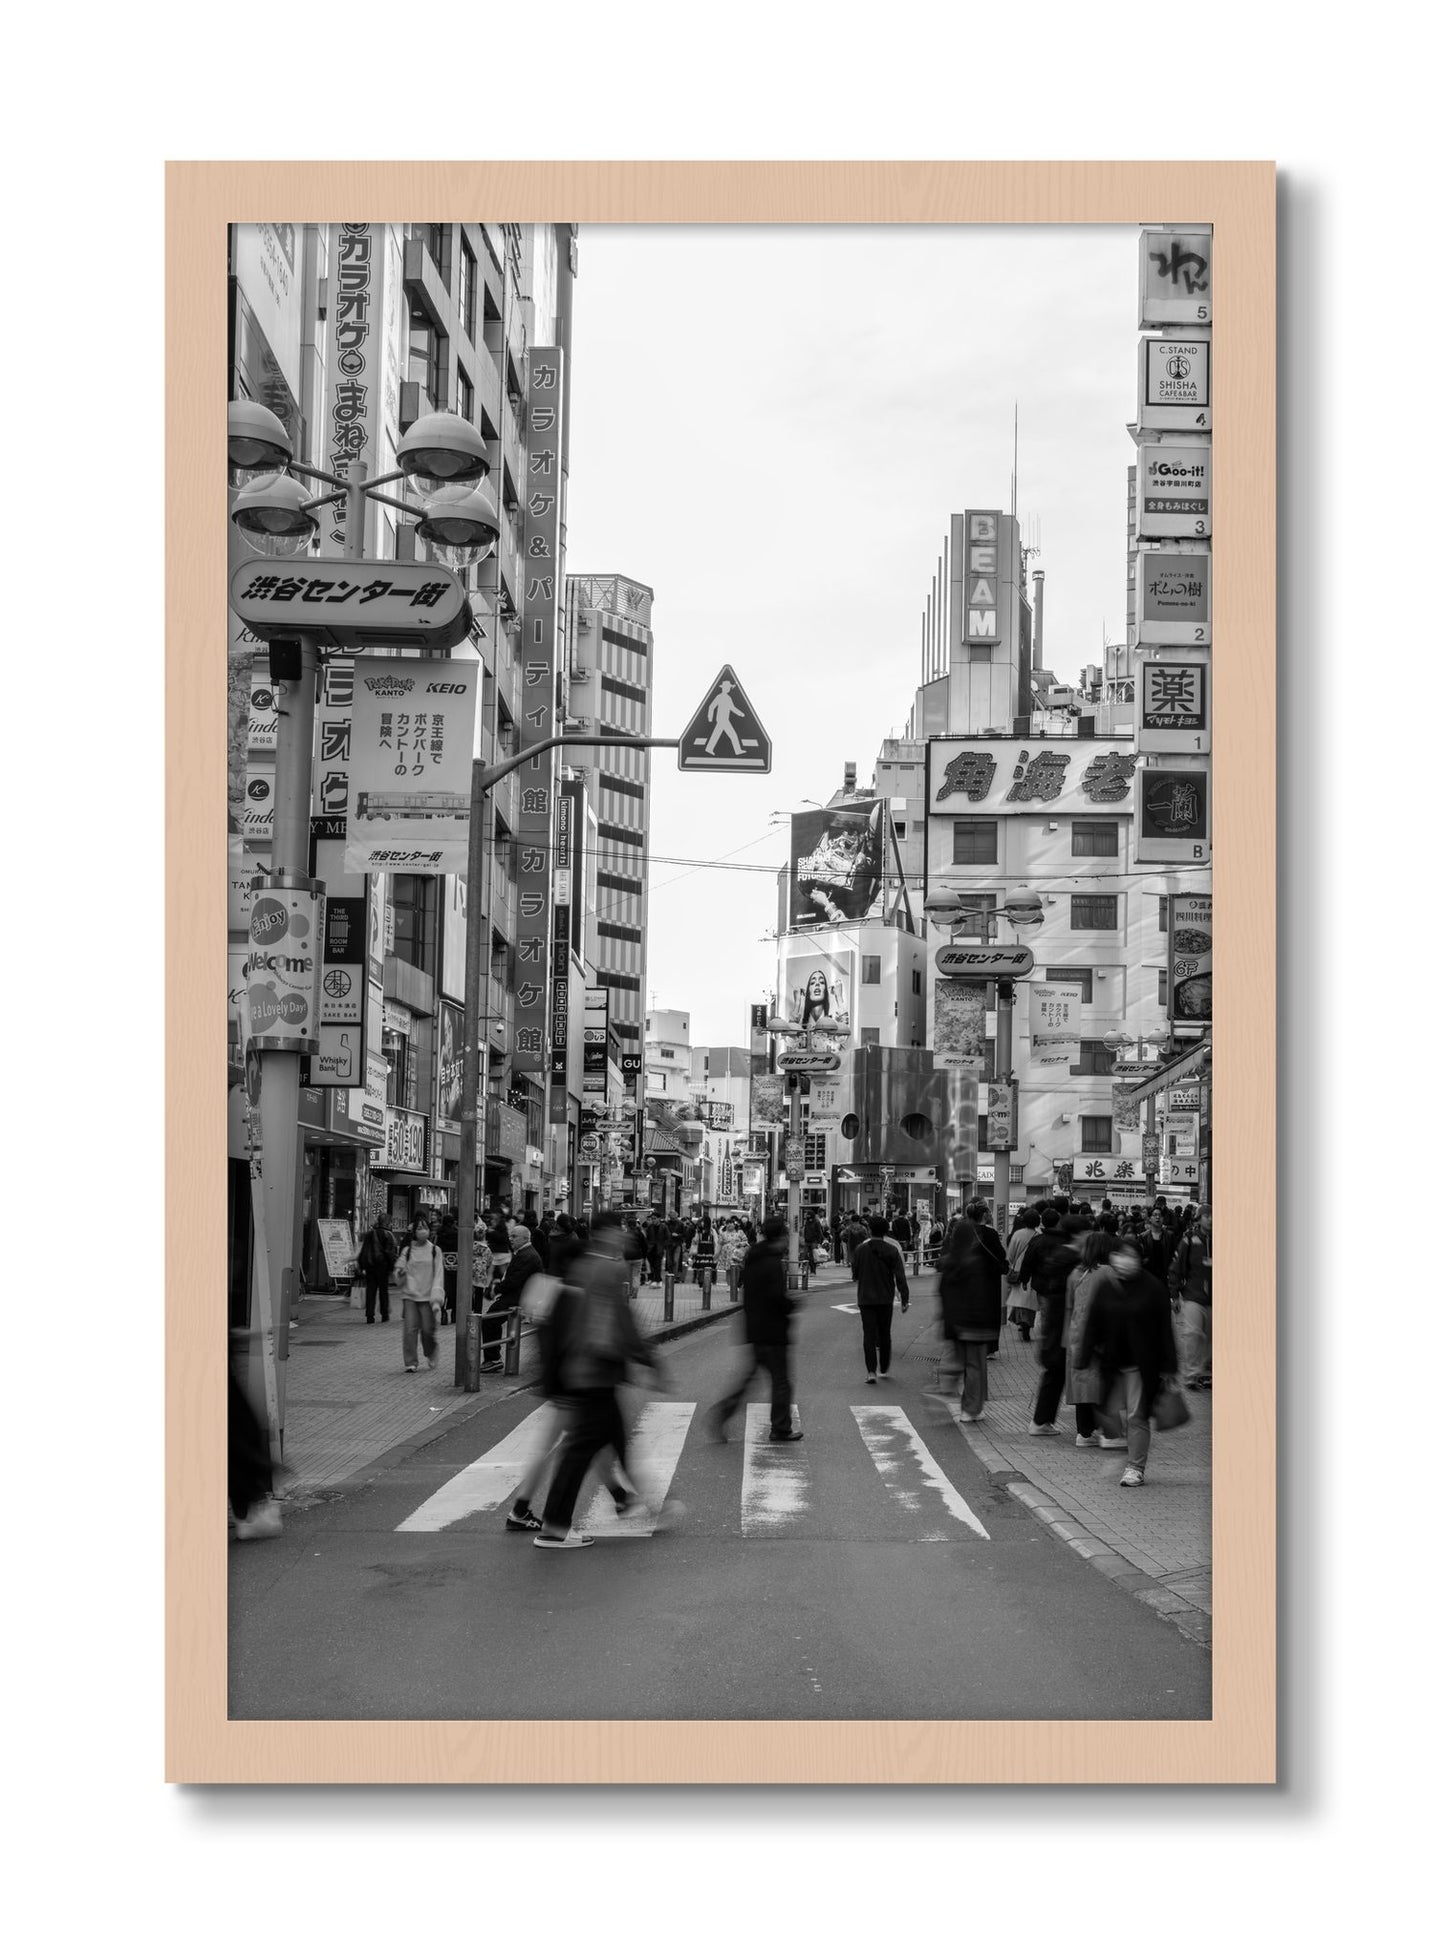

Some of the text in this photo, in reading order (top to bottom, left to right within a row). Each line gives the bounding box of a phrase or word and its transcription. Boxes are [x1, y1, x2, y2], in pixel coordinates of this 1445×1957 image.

[339, 235, 371, 350] カラオケ
[1197, 307, 1208, 319] 5
[1159, 346, 1198, 354] C.STAND
[1159, 380, 1197, 390] SHISHA
[1195, 412, 1206, 427] 4
[1158, 463, 1204, 477] Goo-it!
[1147, 501, 1205, 511] 全身もみほぐし
[1195, 520, 1205, 534] 3
[970, 514, 996, 636] BEAM
[241, 575, 451, 608] 渋谷センター街
[1194, 627, 1205, 641] 2
[425, 682, 467, 694] KEIO
[1152, 669, 1194, 712] 薬
[1146, 714, 1199, 727] マツモトキヨシ
[378, 713, 393, 749] 冒険へ
[251, 736, 273, 744] 渋谷店
[394, 713, 410, 776] カントーの
[430, 714, 445, 764] 京王線で
[1194, 736, 1202, 750] 1
[936, 750, 1139, 802] 角海老
[1146, 783, 1198, 825] 一蘭
[248, 827, 269, 835] 渋谷店
[559, 801, 568, 864] kimono hearts
[368, 850, 443, 862] 渋谷センター街
[1193, 845, 1203, 858] B
[252, 908, 285, 938] Enjoy
[516, 848, 546, 1053] カラオケ館
[248, 951, 313, 973] Welcome
[941, 953, 1028, 964] 渋谷センター街
[1174, 960, 1199, 978] 6F
[262, 1001, 289, 1017] Lovely
[289, 1001, 307, 1013] Day!
[319, 1056, 348, 1066] Whisky
[623, 1059, 641, 1069] GU
[780, 1056, 833, 1065] 渋谷センター街
[1085, 1160, 1135, 1178] 兆楽
